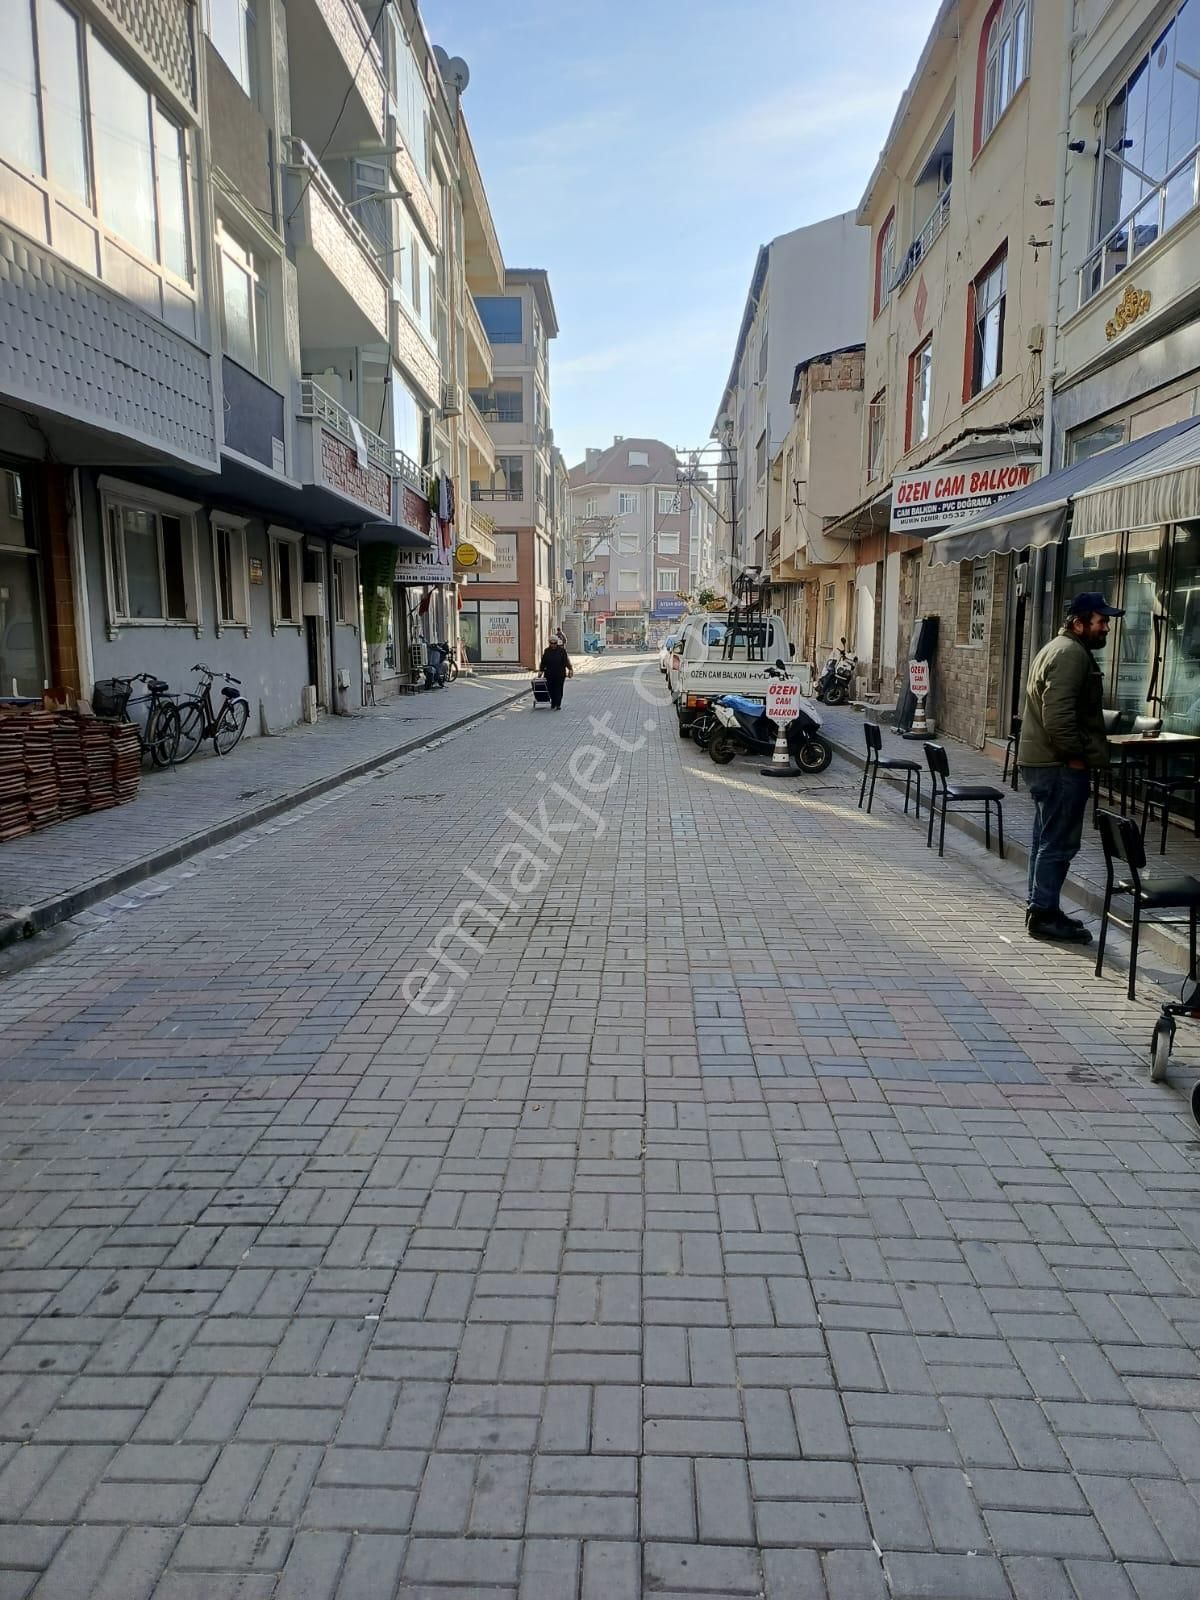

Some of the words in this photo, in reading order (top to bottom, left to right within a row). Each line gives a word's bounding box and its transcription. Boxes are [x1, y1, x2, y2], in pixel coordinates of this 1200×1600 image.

[897, 480, 931, 504] ÖZEN
[934, 475, 965, 498] CAM
[970, 466, 1030, 493] BALKON
[896, 508, 911, 518] CAM
[911, 505, 937, 516] BALKON
[942, 501, 956, 512] PVC
[942, 511, 966, 520] 0532
[708, 671, 721, 679] CAM
[722, 671, 747, 679] BALKON
[769, 683, 798, 695] ÖZEN
[775, 697, 791, 705] CAM
[768, 708, 798, 717] BALKON
